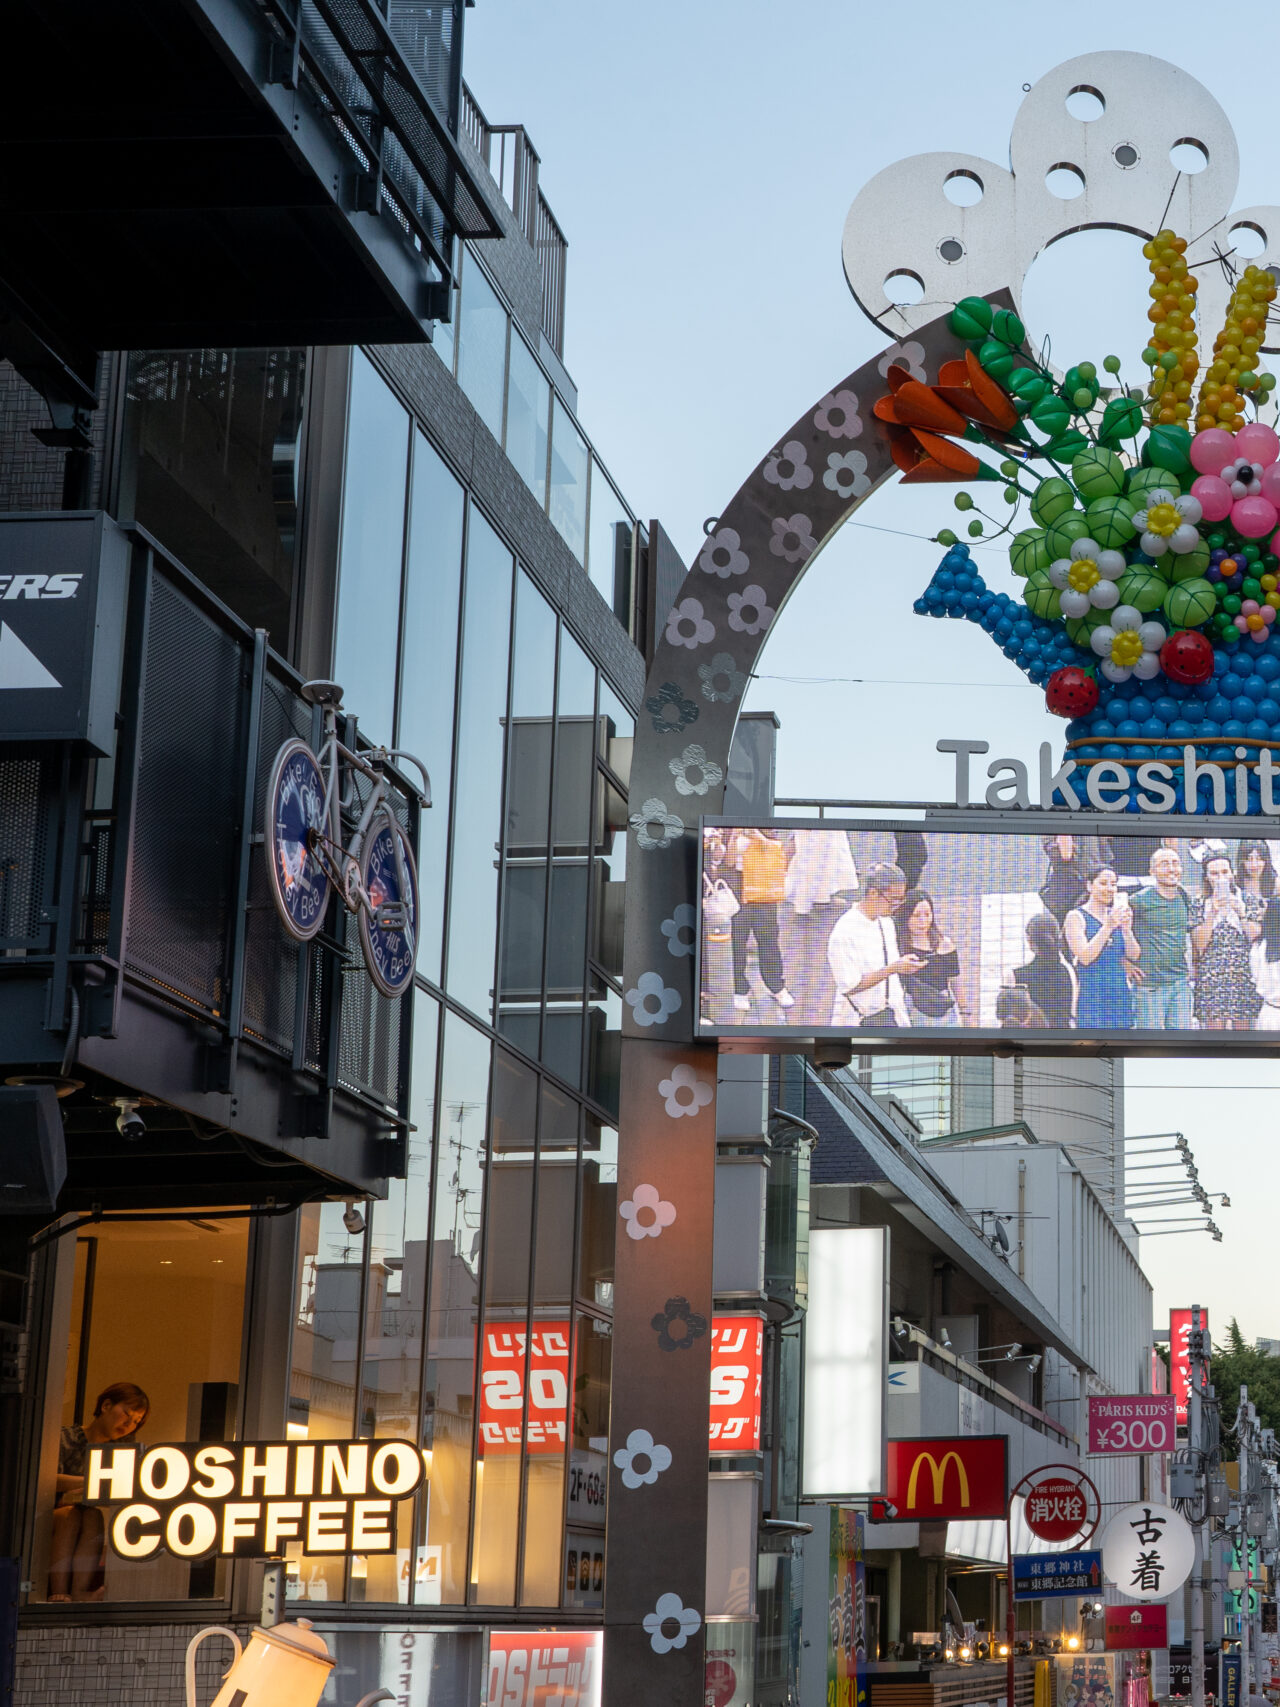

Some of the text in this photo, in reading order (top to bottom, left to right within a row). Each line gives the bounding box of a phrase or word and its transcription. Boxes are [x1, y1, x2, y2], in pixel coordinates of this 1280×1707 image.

[370, 837, 394, 876] Bike
[390, 955, 411, 978] Bee
[1098, 1401, 1167, 1416] PARIS KID'S
[1097, 1421, 1166, 1449] ¥300
[87, 1442, 421, 1500] HOSHINO
[1049, 1485, 1076, 1493] HYDRANT
[1031, 1496, 1082, 1522] 消火栓
[113, 1500, 392, 1557] COFFEE
[1130, 1508, 1167, 1592] 古着
[1030, 1560, 1085, 1575] 東郷神社
